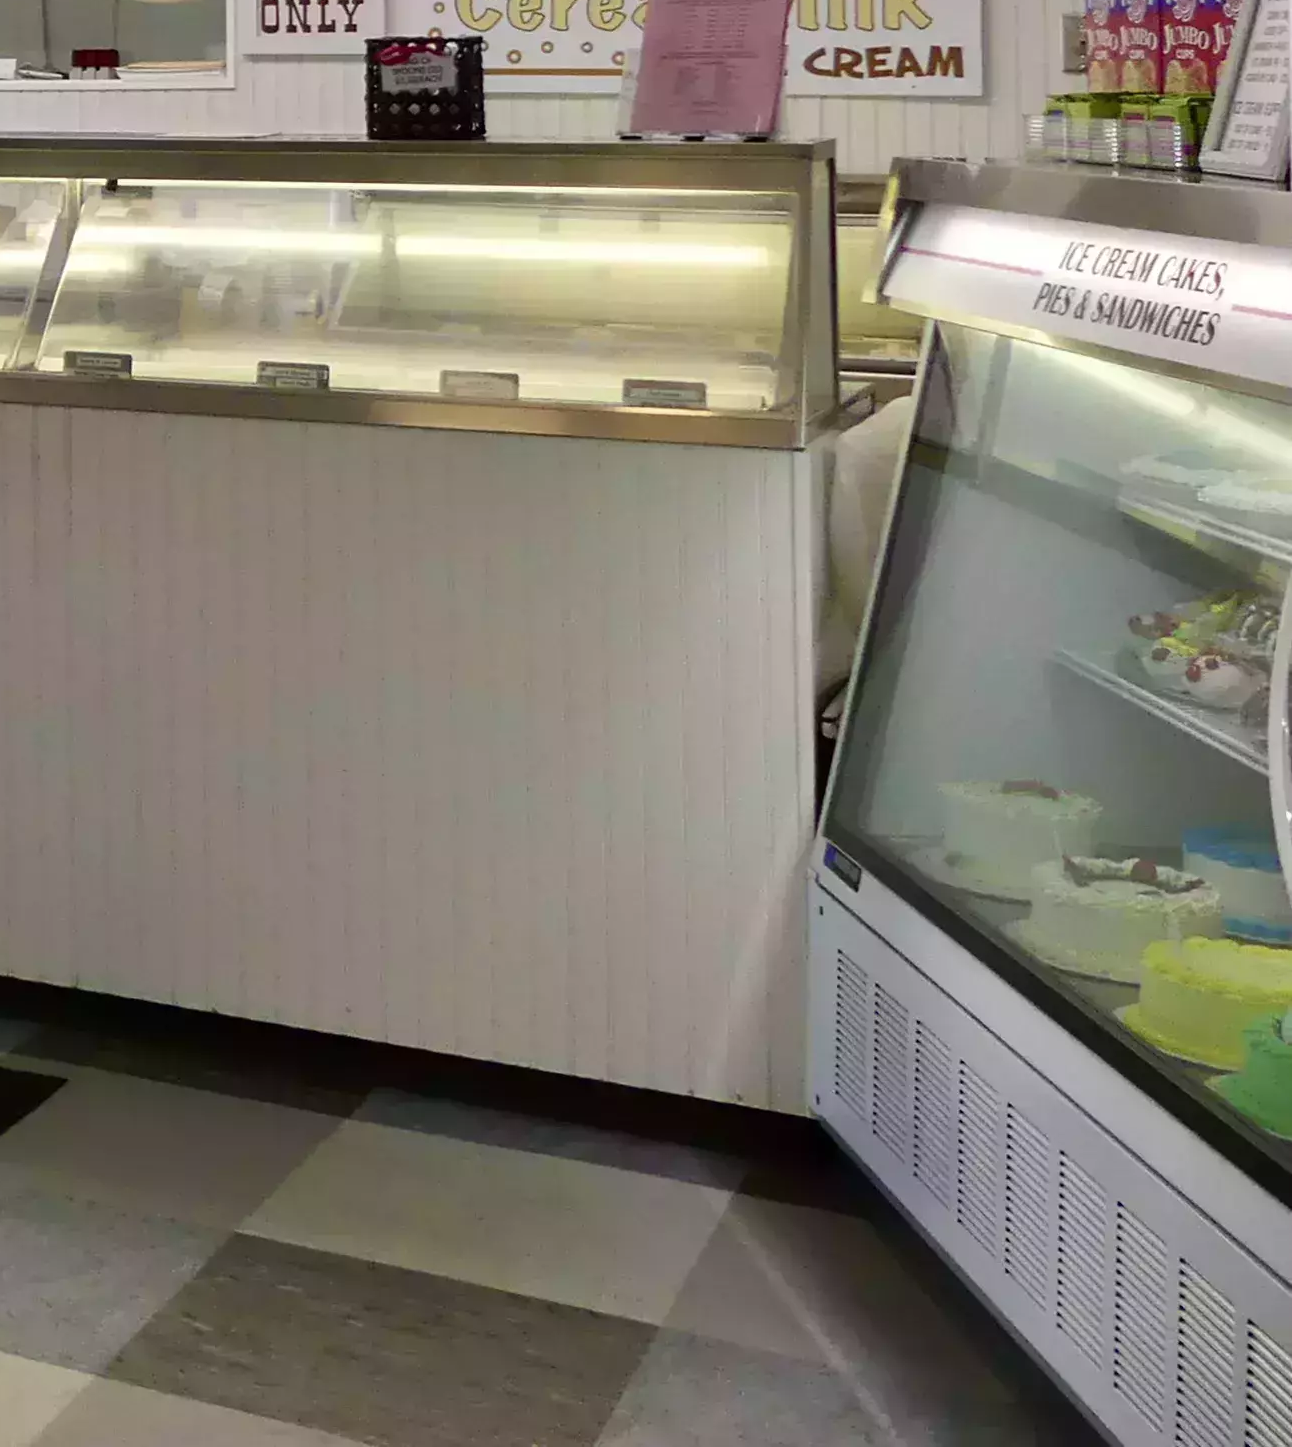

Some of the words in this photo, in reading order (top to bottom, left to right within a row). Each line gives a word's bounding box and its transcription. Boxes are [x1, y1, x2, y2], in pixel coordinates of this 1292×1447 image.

[803, 45, 965, 79] CREAM
[1163, 23, 1210, 55] JUMBO
[1058, 240, 1092, 273] ICE
[1091, 246, 1160, 285] CREAM
[1156, 254, 1229, 300] CAKES,
[1032, 282, 1074, 317] PIES
[1073, 290, 1093, 320] &
[1091, 293, 1222, 346] SANDWICHES
